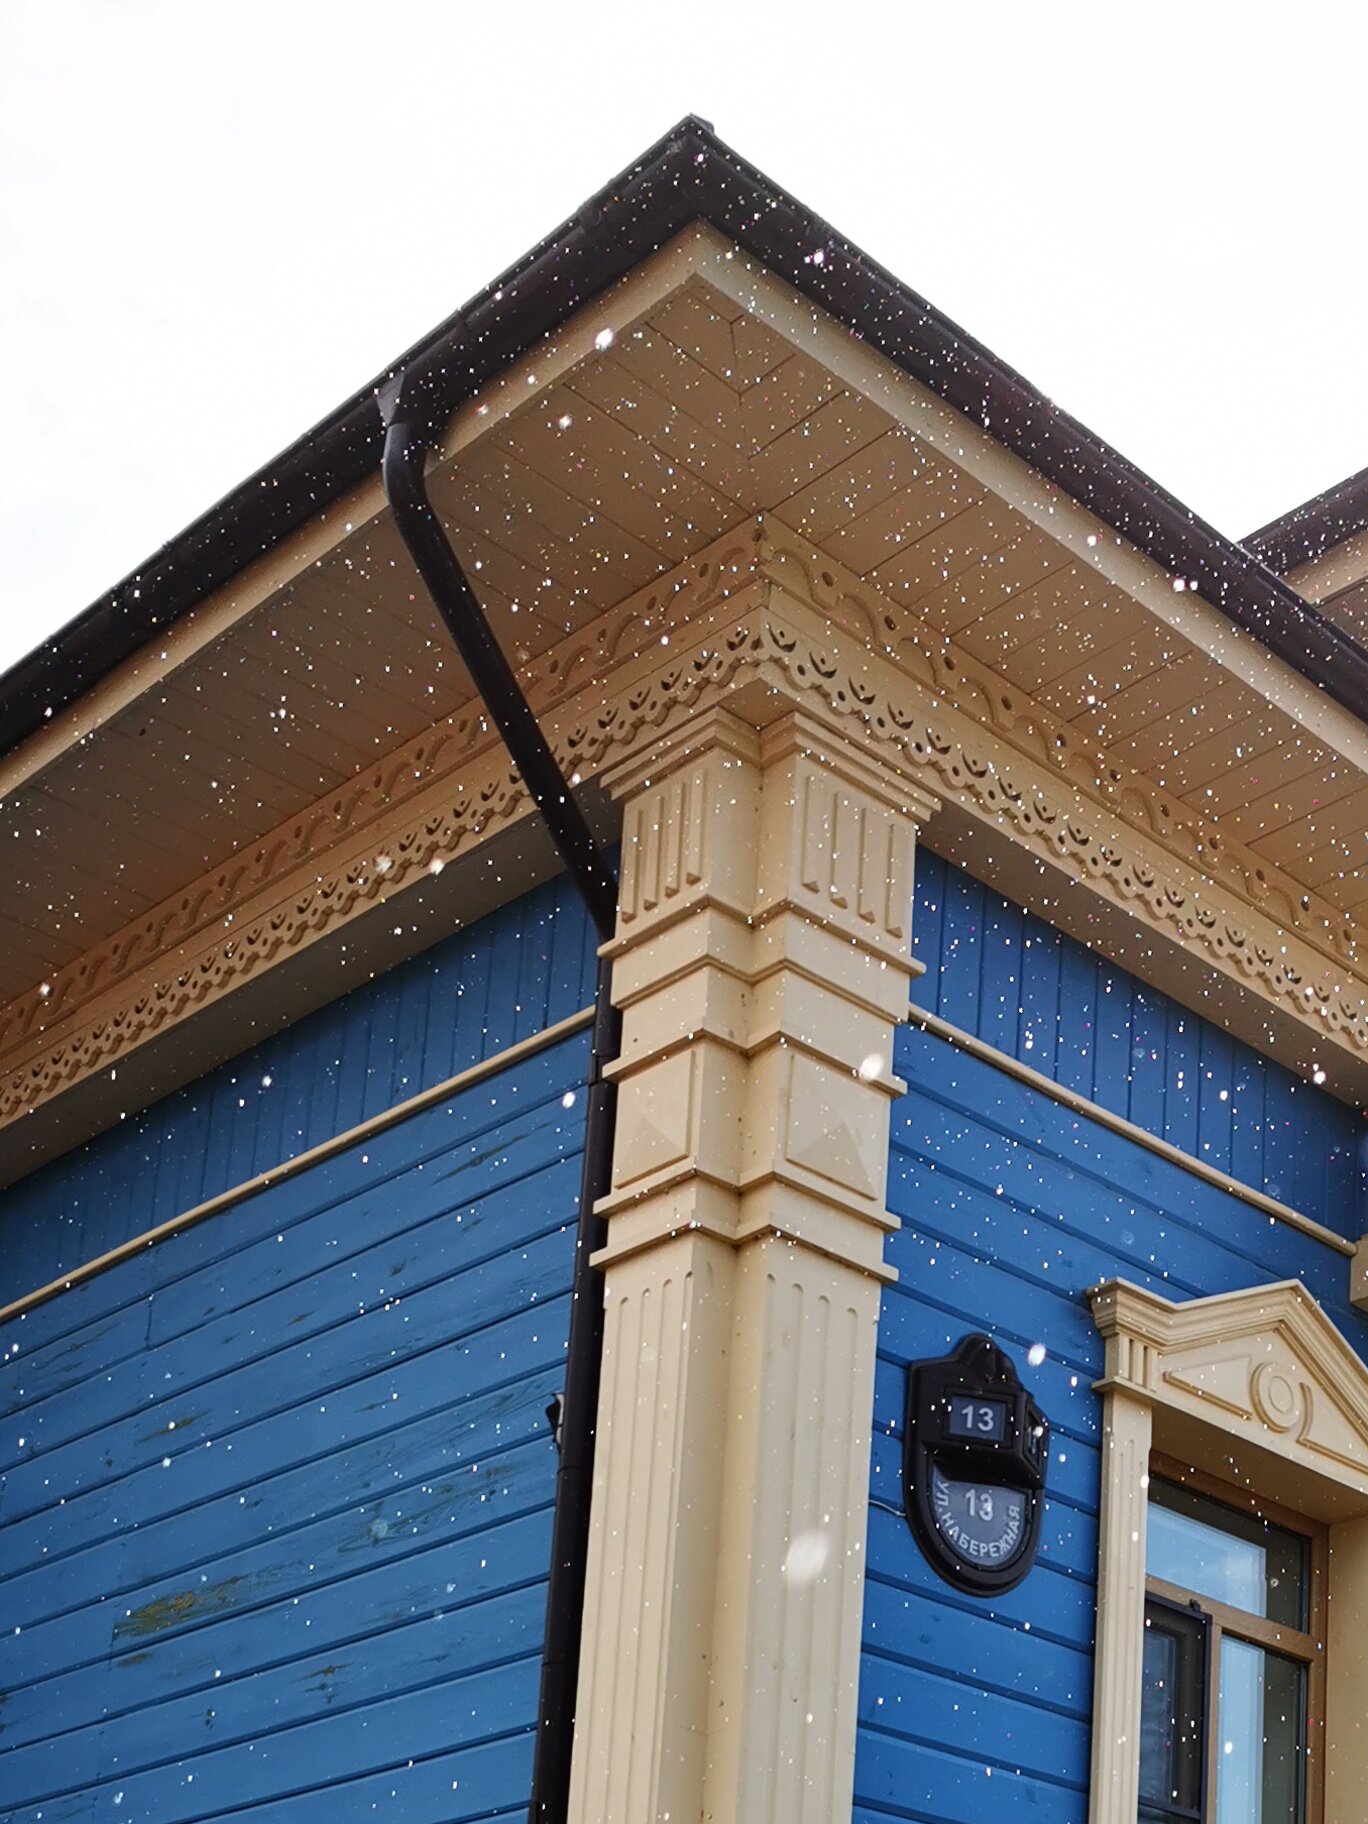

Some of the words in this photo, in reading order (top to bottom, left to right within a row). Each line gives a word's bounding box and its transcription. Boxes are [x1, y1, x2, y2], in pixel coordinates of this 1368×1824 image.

[962, 1405, 994, 1431] 13
[935, 1480, 950, 1511] УЛ.
[965, 1489, 994, 1521] 13
[941, 1504, 1021, 1558] НАБЕРЕЖНАЯ
